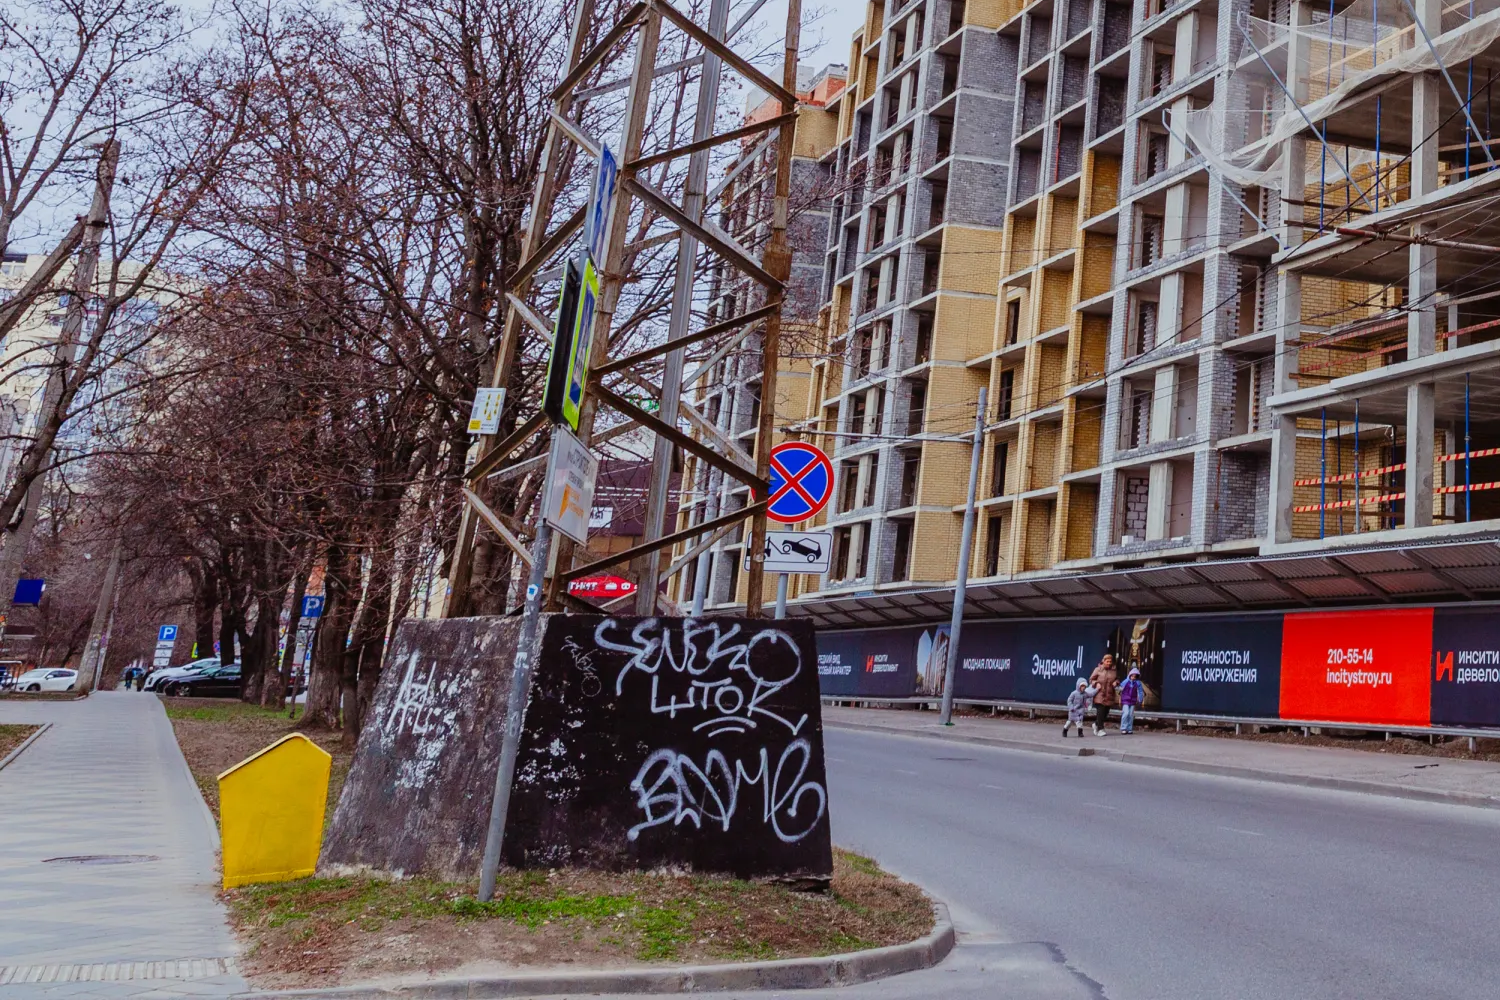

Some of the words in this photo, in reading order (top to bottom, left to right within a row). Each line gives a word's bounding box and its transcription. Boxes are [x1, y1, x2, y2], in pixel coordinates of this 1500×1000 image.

[163, 627, 174, 639] P
[1181, 650, 1242, 665] ИЗБРАННОСТЬ
[1242, 650, 1250, 665] И
[1327, 648, 1374, 665] 210-55-14
[963, 658, 985, 671] МОДНАЯ
[985, 658, 1011, 672] ЛОКАЦИЯ
[1031, 653, 1076, 679] Эндемик
[1180, 667, 1203, 682] СИЛА
[1203, 667, 1257, 683] ОКРУЖЕНИЯ
[1326, 668, 1393, 688] incitystroy.ru
